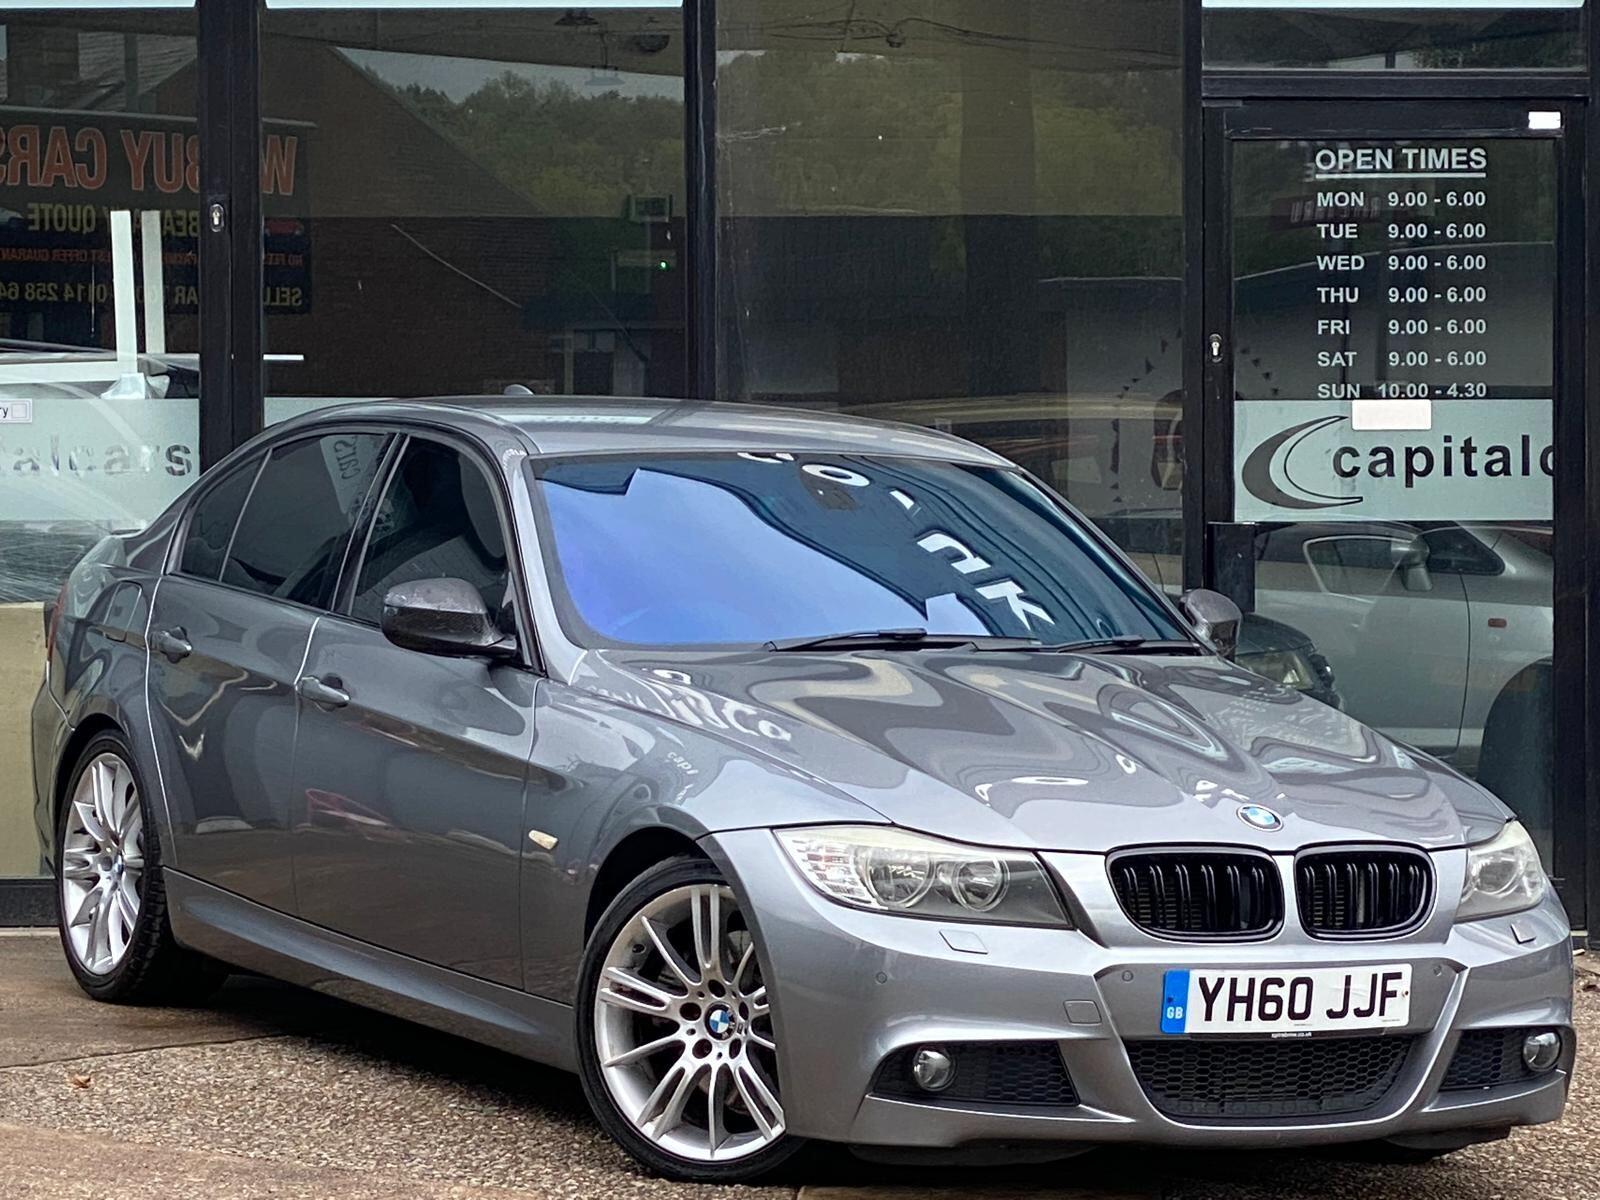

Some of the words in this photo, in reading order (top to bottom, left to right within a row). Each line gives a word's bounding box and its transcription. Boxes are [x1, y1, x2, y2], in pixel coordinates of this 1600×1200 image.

[1315, 149, 1393, 171] OPEN
[1401, 148, 1487, 170] TIMES
[1317, 191, 1365, 208] MON
[1387, 191, 1428, 207] 9.00
[1446, 191, 1486, 207] 6.00
[1317, 223, 1359, 239] TUE
[1388, 223, 1428, 239] 9.00
[1446, 223, 1486, 239] 6.00
[1316, 255, 1365, 271] WED
[1388, 255, 1428, 271] 9.00
[1446, 254, 1486, 270] 6.00
[1316, 287, 1359, 303] THU
[1388, 287, 1428, 303] 9.00
[1446, 286, 1486, 303] 6.00
[1317, 319, 1350, 335] FRI
[1388, 319, 1428, 335] 9.00
[1446, 318, 1487, 335] 6.00
[1317, 351, 1358, 367] SAT
[1388, 351, 1429, 367] 9.00
[1447, 350, 1487, 366] 6.00
[1317, 383, 1361, 399] SUN
[1378, 382, 1429, 398] 10.00
[1446, 382, 1487, 398] 4.30
[1198, 976, 1315, 1022] YH60
[1325, 971, 1404, 1020] JJF
[1166, 1005, 1184, 1020] GB
